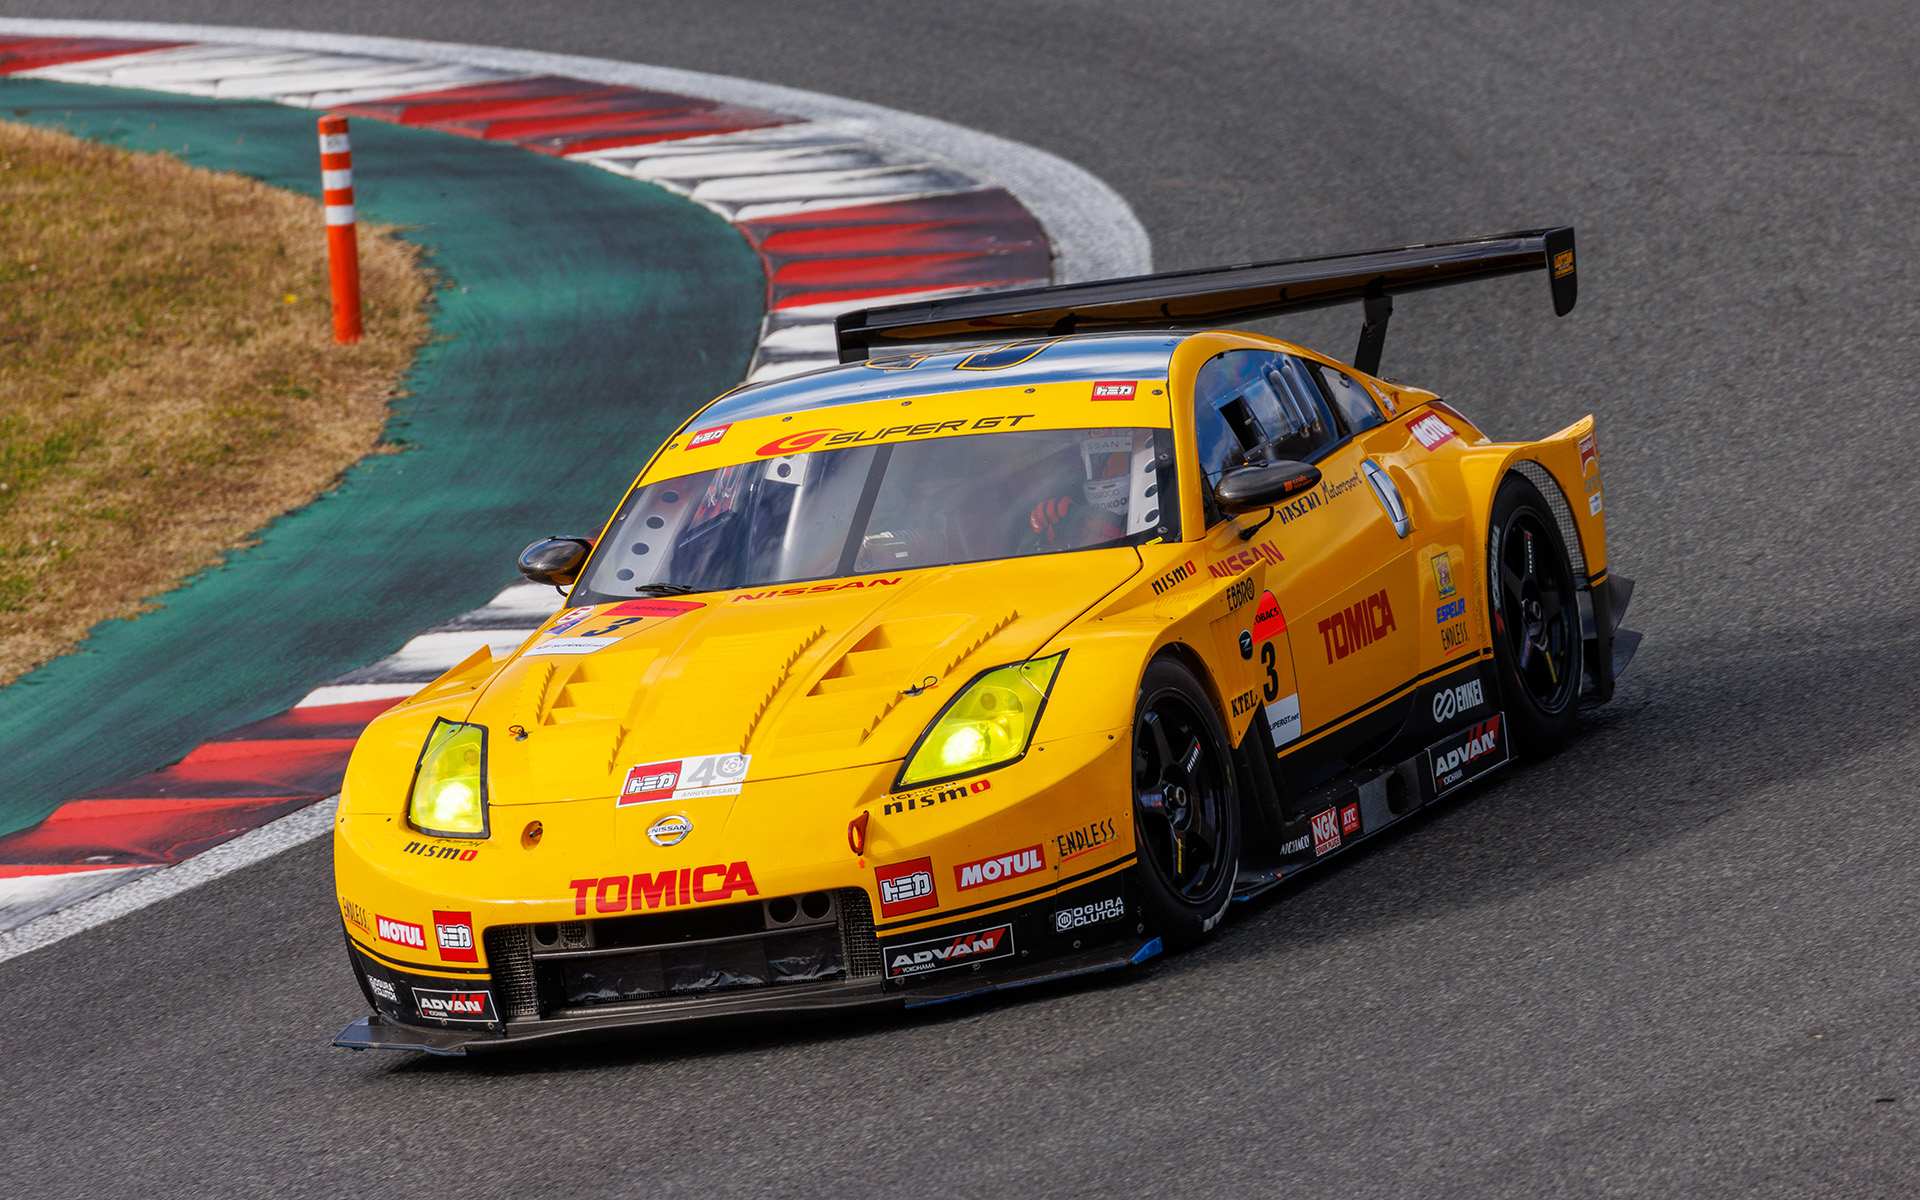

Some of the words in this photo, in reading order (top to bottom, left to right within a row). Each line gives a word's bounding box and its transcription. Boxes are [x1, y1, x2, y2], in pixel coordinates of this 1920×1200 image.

[1094, 384, 1135, 396] トミカ
[825, 419, 968, 446] SUPER
[971, 414, 1036, 430] GT
[1411, 415, 1455, 447] MOTUL
[1320, 468, 1363, 505] Motorsport
[1208, 539, 1285, 578] NISSAN
[732, 577, 902, 603] NISSAN
[1151, 560, 1197, 595] nismo
[1254, 606, 1279, 625] OBACS
[1437, 598, 1466, 624] ESPEUR
[581, 617, 643, 637] 3
[1317, 588, 1397, 666] TOMICA
[1441, 621, 1468, 651] ENDLESS
[1261, 641, 1279, 702] 3
[1455, 678, 1484, 713] ENKEI
[1435, 730, 1496, 777] ADVAN
[627, 772, 677, 795] トミカ
[687, 755, 746, 788] 40
[681, 787, 739, 798] ANNIVERSARY
[884, 779, 991, 816] nismo
[651, 824, 688, 834] NISSAN
[1057, 818, 1116, 857] ENDLESS
[1312, 810, 1338, 845] NGK
[403, 841, 479, 862] nismo
[960, 849, 1042, 888] MOTUL
[569, 861, 759, 916] TOMICA
[880, 871, 932, 904] トミカ
[342, 896, 368, 929] ENDLESS
[1073, 897, 1123, 916] OGURA
[1074, 906, 1125, 927] CLUTCH
[378, 919, 424, 946] MOTUL
[436, 924, 473, 949] トミカ
[891, 938, 994, 968] ADVAN
[901, 962, 936, 974] YOKOHAMA
[421, 998, 482, 1012] ADVAN
